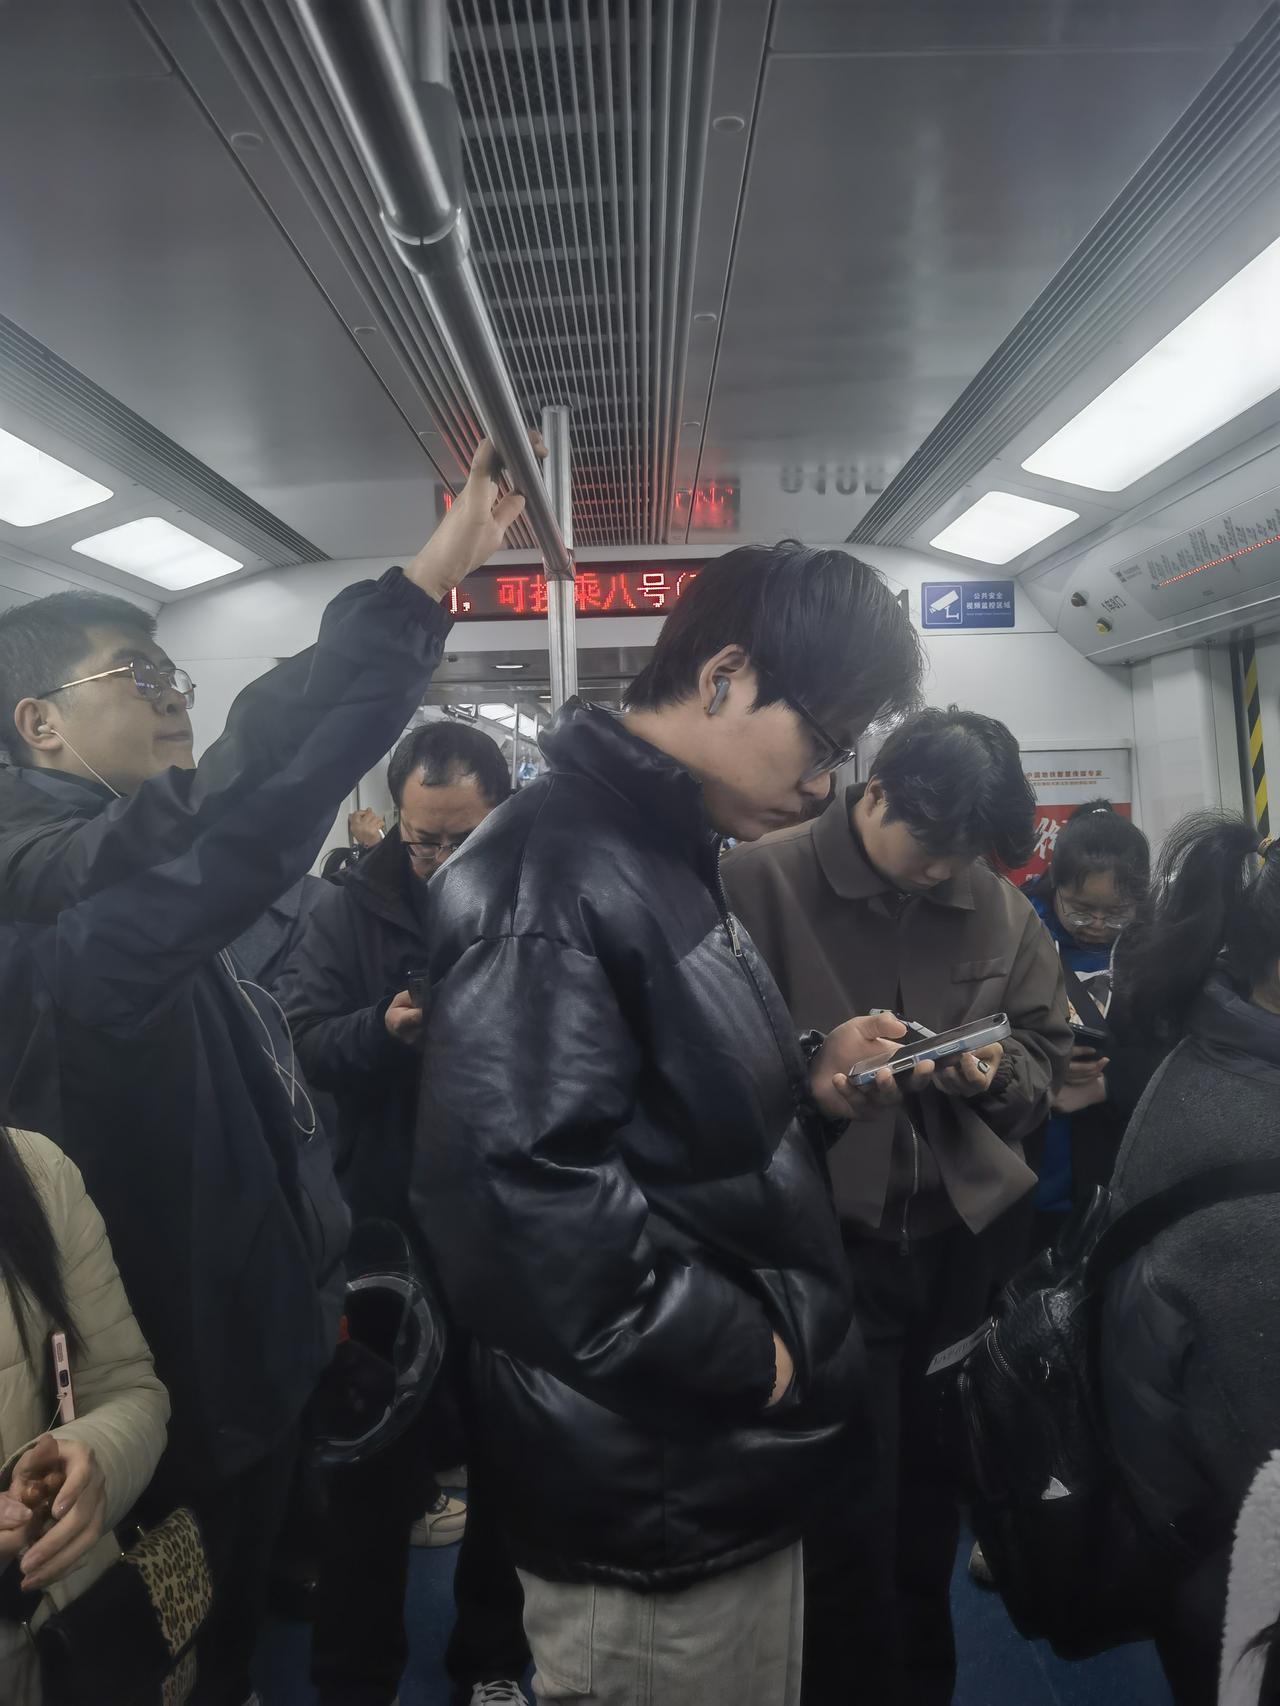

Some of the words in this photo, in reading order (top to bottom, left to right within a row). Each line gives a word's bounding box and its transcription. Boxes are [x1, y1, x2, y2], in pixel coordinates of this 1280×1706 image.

[973, 592, 1003, 600] 公共安全
[966, 601, 1011, 610] 视频监控区域
